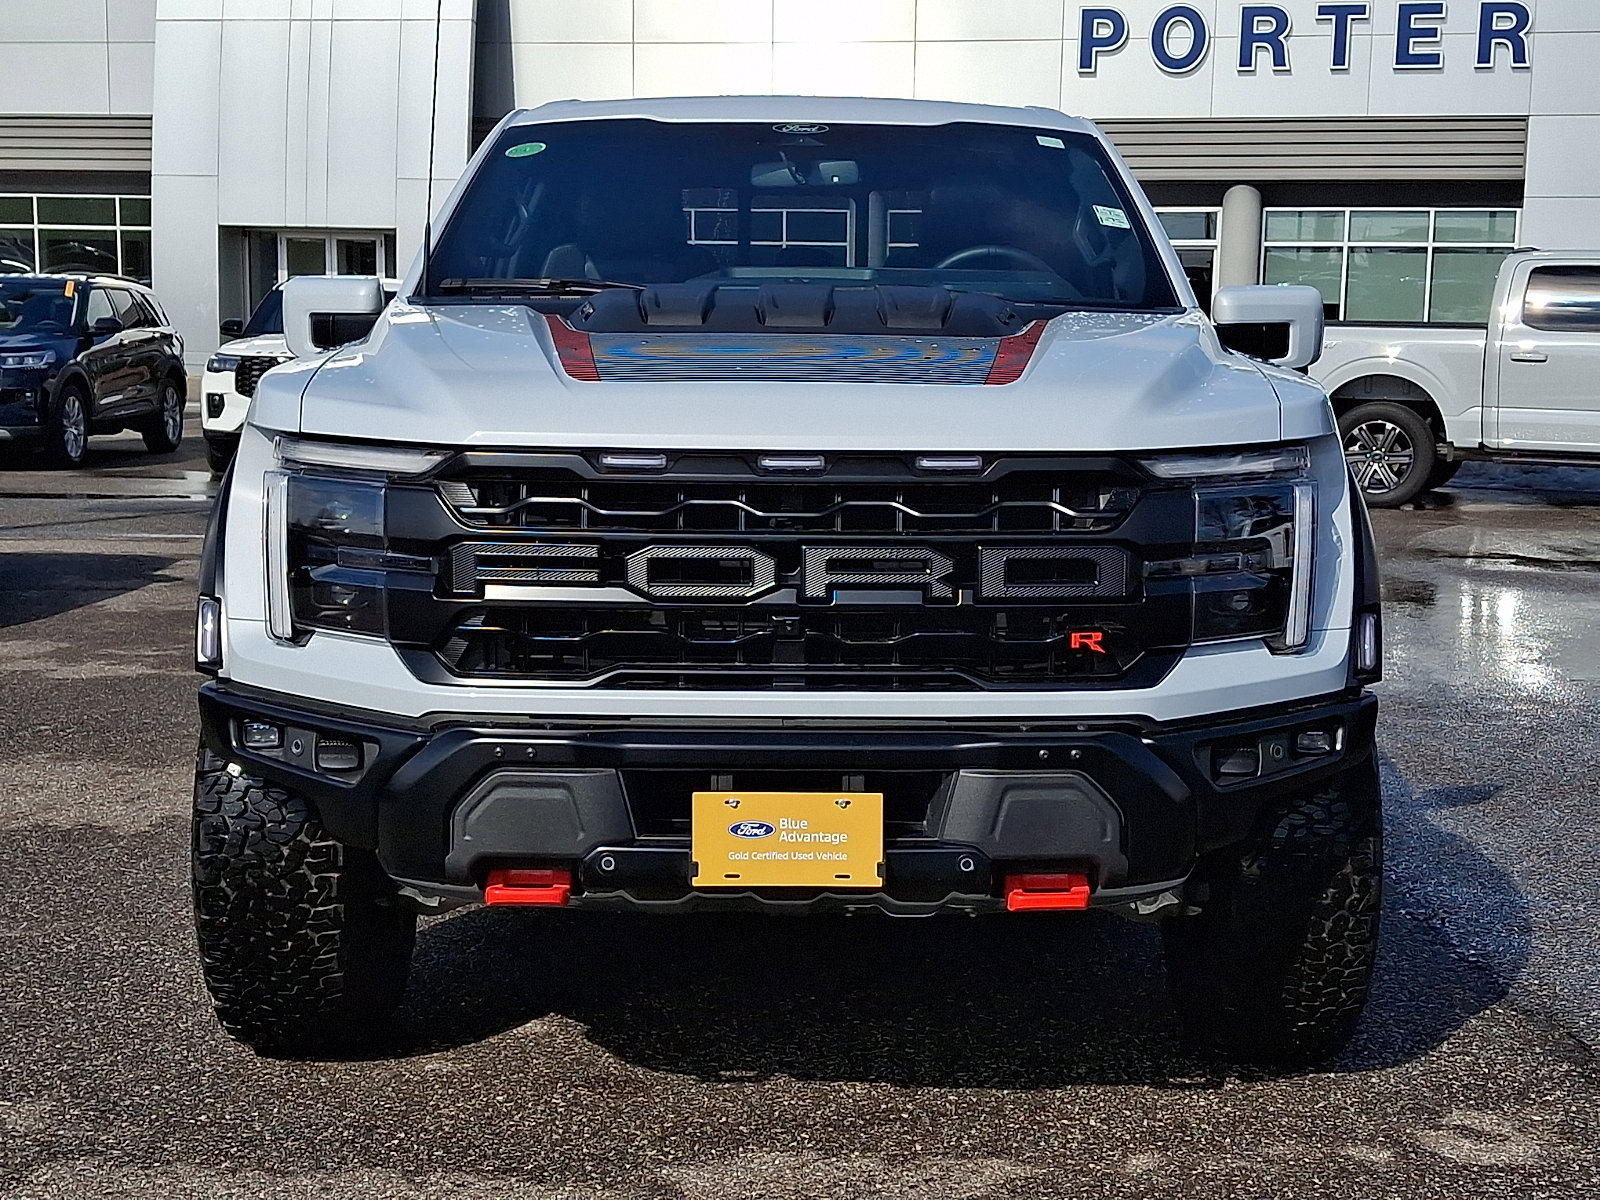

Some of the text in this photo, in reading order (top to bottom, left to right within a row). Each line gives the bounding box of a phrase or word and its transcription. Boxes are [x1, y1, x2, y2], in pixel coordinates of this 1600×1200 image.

[1078, 1, 1533, 75] PORTER
[450, 542, 1128, 598] FORD
[1071, 632, 1106, 653] R
[737, 823, 767, 836] Ford
[779, 818, 808, 829] Blue
[779, 831, 848, 844] Advantage
[728, 851, 848, 861] Gold Certified Used Vehicle
